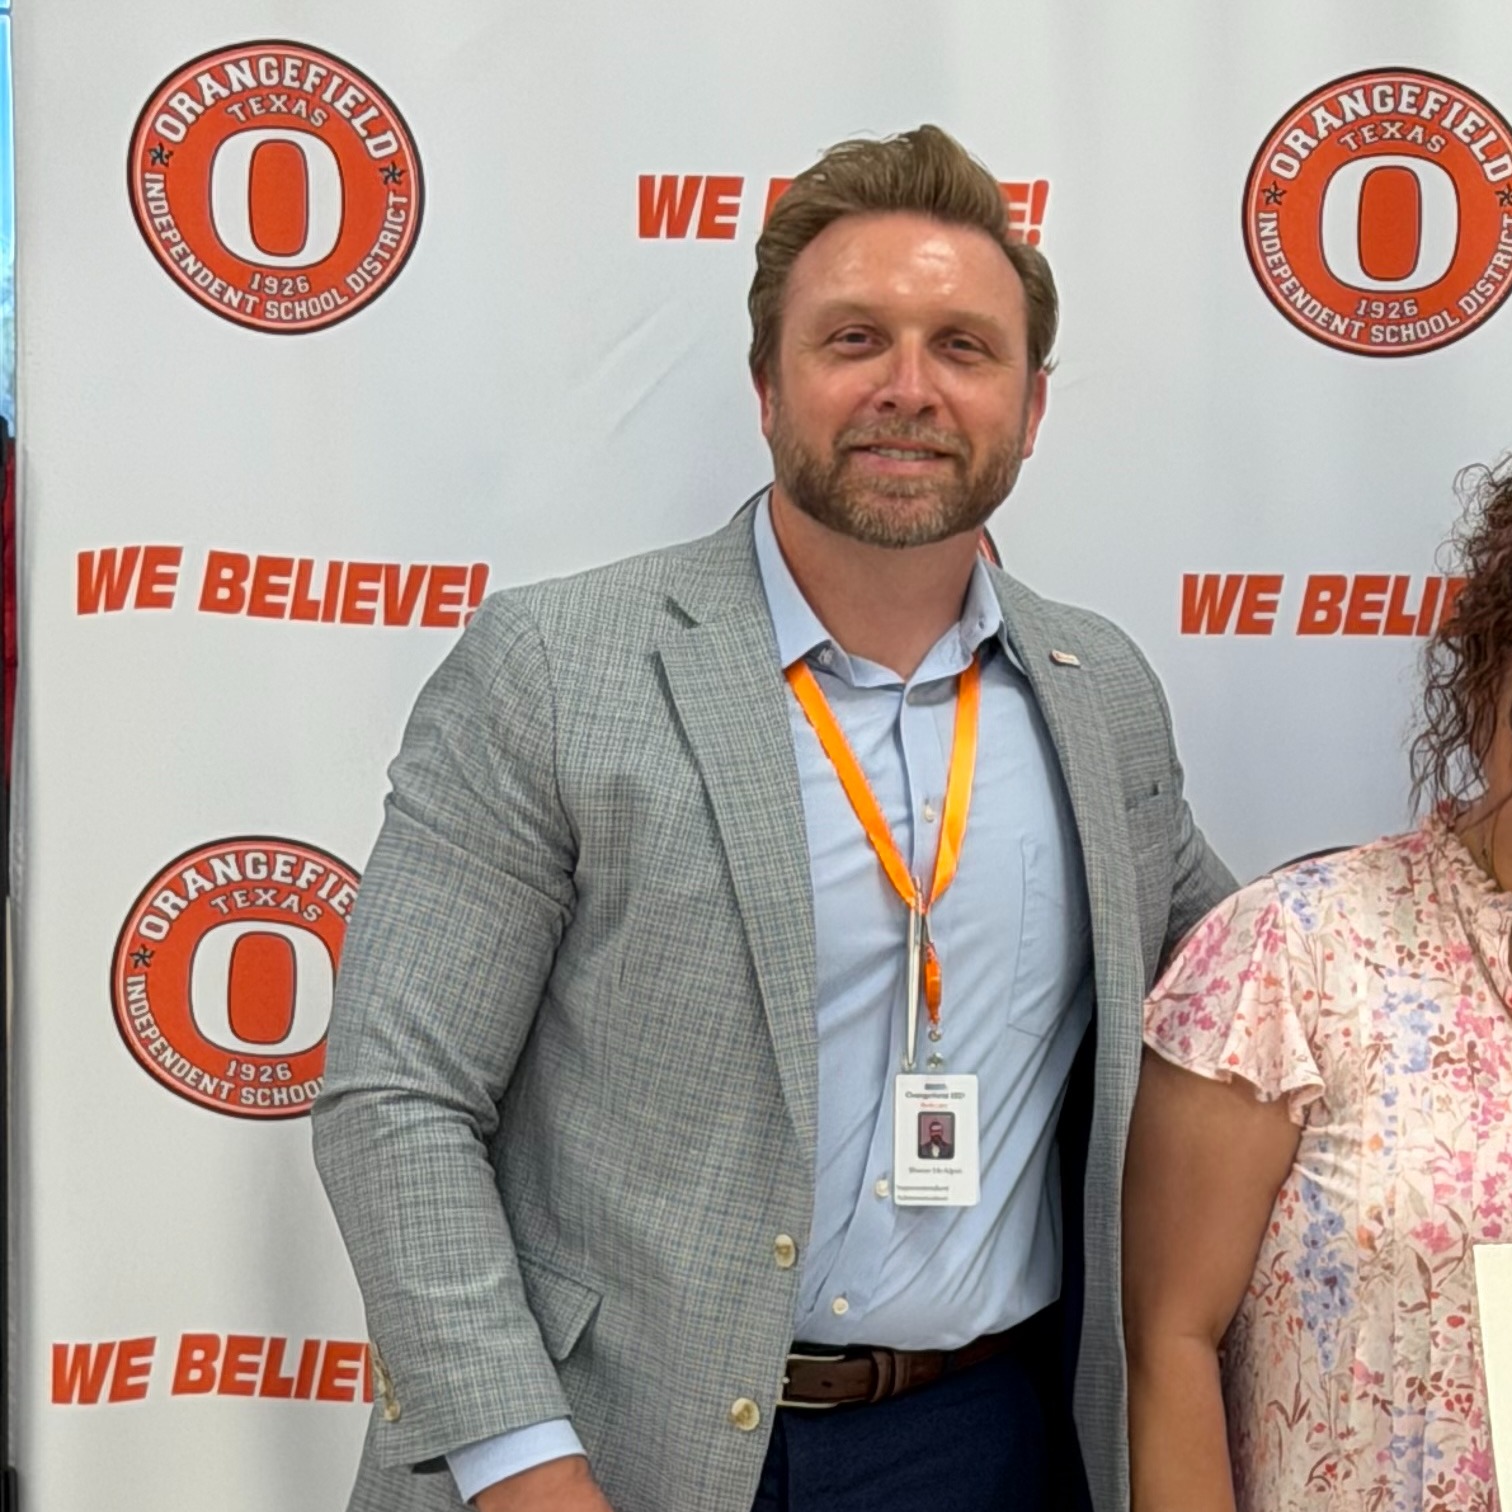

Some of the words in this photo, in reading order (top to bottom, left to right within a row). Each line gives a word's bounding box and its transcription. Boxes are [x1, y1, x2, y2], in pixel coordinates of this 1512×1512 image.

[155, 57, 399, 158] ORANGEFIELD
[228, 95, 328, 127] TEXAS
[1341, 122, 1445, 153] TEXAS
[212, 128, 343, 268] O
[639, 176, 743, 239] WE
[1322, 155, 1458, 291] O
[145, 173, 259, 312] INDEPENDENT
[265, 289, 348, 319] SCHOOL
[346, 192, 408, 293] DISTRICT
[251, 274, 309, 294] 1926
[1259, 212, 1365, 339] INDEPENDENT
[1371, 311, 1460, 342] SCHOOL
[1357, 299, 1417, 318] 1926
[77, 546, 181, 614] WE
[199, 550, 489, 627] BELIEVE!
[1181, 574, 1283, 635] WE
[139, 852, 357, 941] ORANGEFIE
[211, 888, 322, 921] TEXAS
[192, 921, 334, 1056] O
[127, 974, 234, 1100] INDEPENDENT
[240, 1077, 325, 1106] SCHOO
[227, 1060, 292, 1081] 1926
[52, 1337, 155, 1404] WE
[172, 1333, 373, 1403] BELIE
